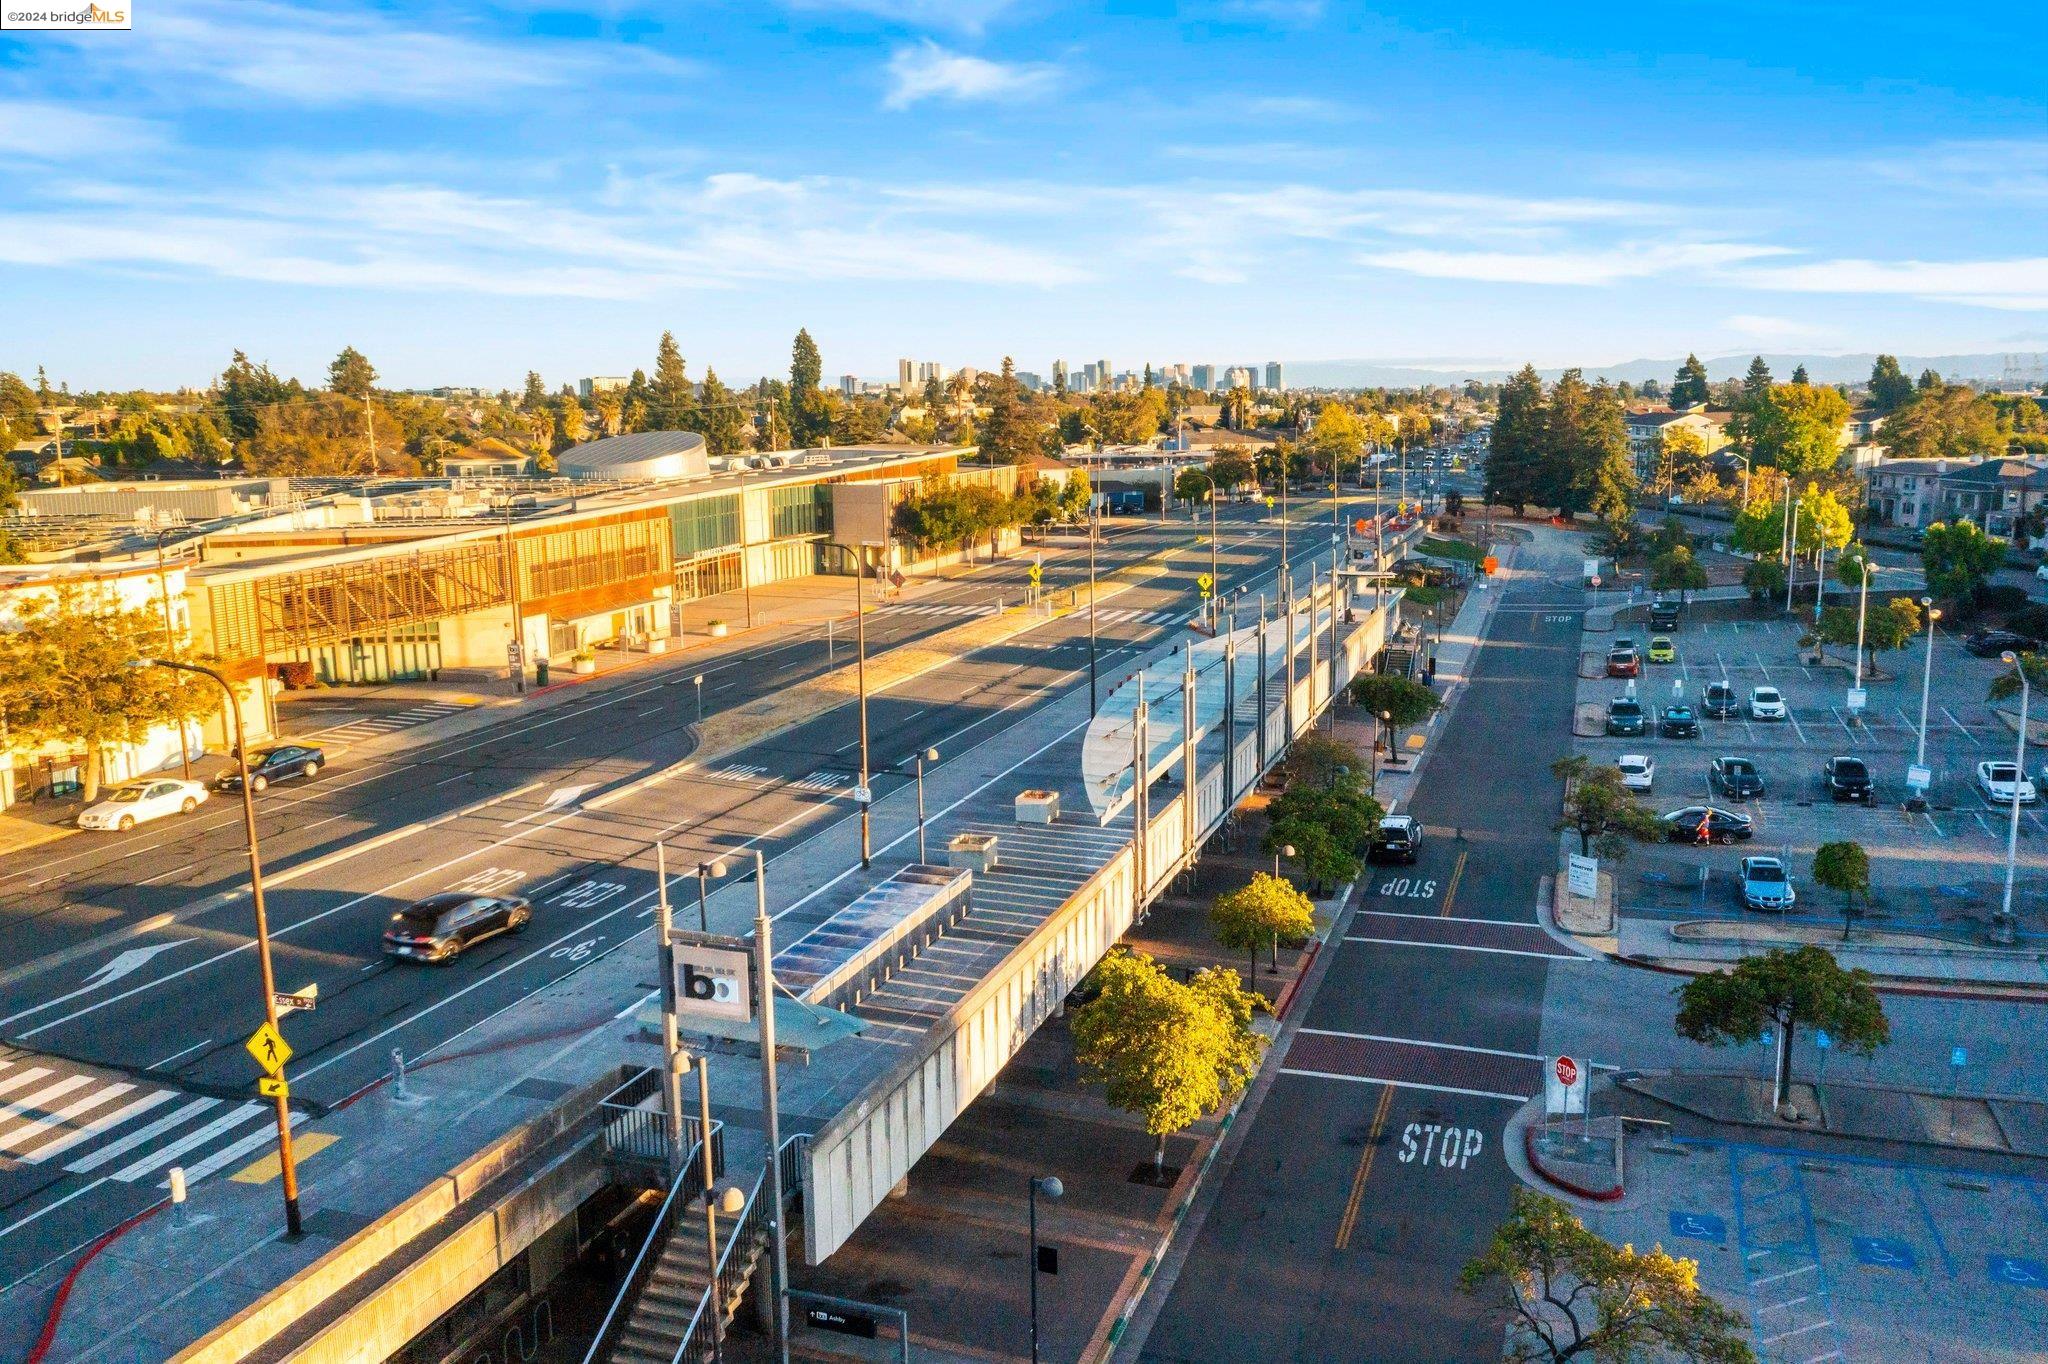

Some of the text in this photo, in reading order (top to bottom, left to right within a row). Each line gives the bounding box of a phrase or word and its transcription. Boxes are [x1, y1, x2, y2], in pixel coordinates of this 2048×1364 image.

[1571, 862, 1593, 871] Reserved
[443, 867, 527, 894] PED
[1380, 877, 1437, 898] STOP
[544, 880, 627, 908] PED
[274, 995, 295, 1005] Essex
[1557, 1063, 1575, 1078] STOP
[1399, 1123, 1483, 1170] STOP
[829, 1315, 846, 1324] Ashby
